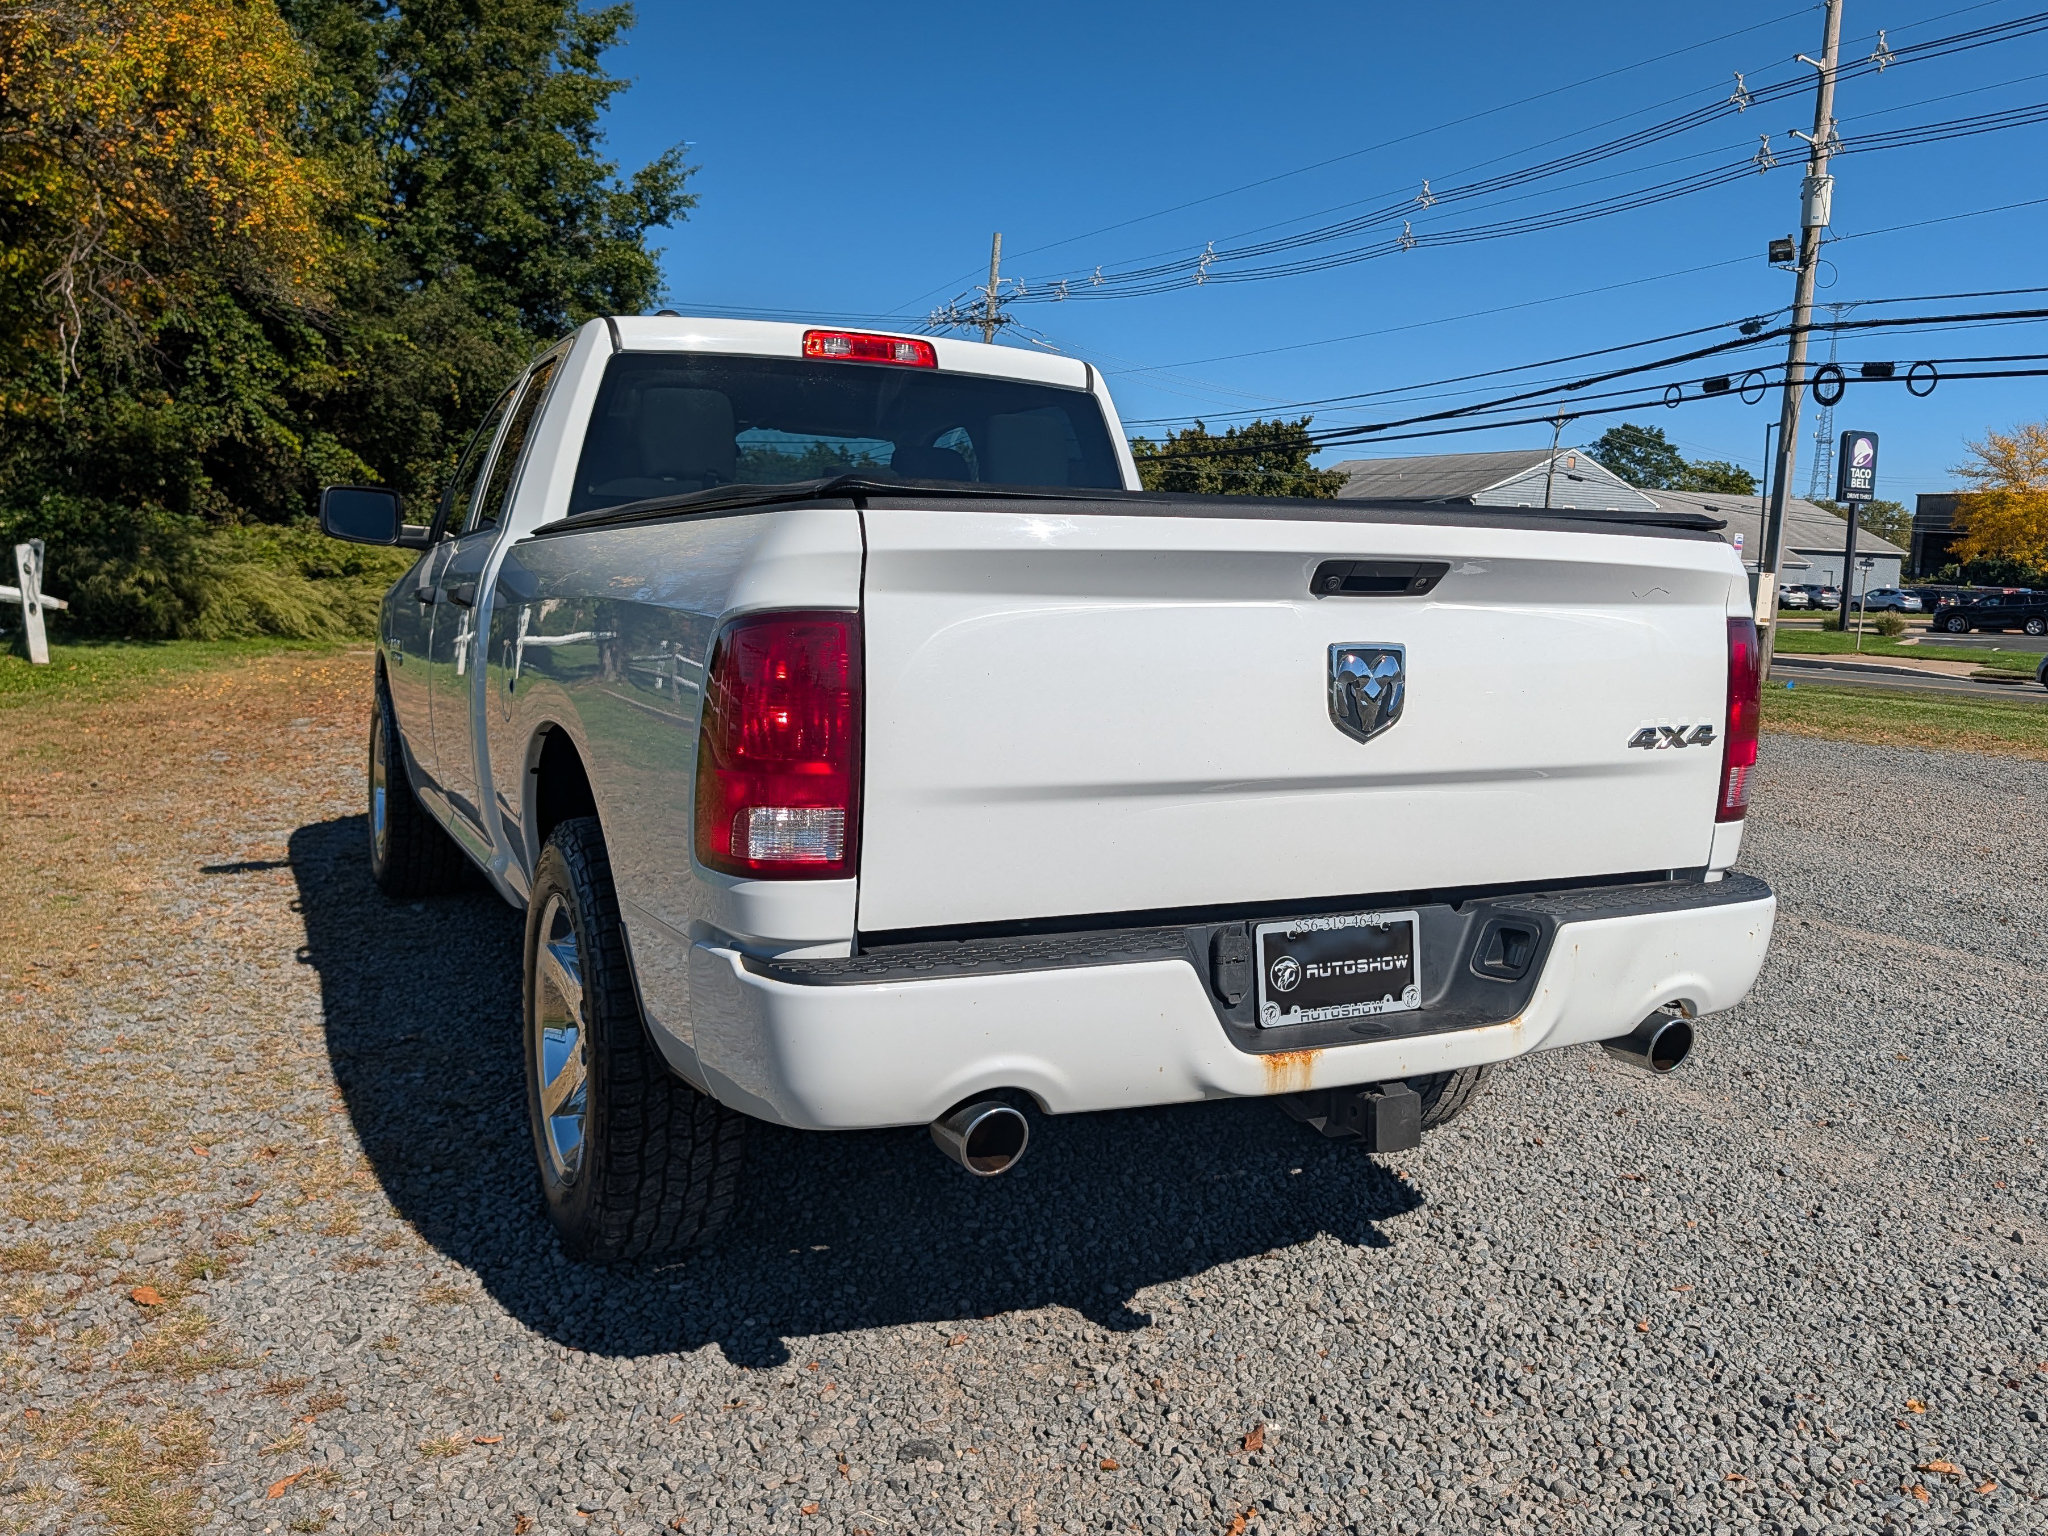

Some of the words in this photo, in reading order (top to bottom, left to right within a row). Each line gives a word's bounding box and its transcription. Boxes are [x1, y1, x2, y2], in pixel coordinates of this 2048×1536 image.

[1850, 468, 1872, 479] TACO
[1850, 478, 1871, 489] BELL
[1628, 724, 1717, 750] 4X4
[1295, 913, 1382, 933] 856-319-4642
[1306, 954, 1409, 979] AUTOSHOW
[1300, 1000, 1385, 1022] AUTOSHOW
